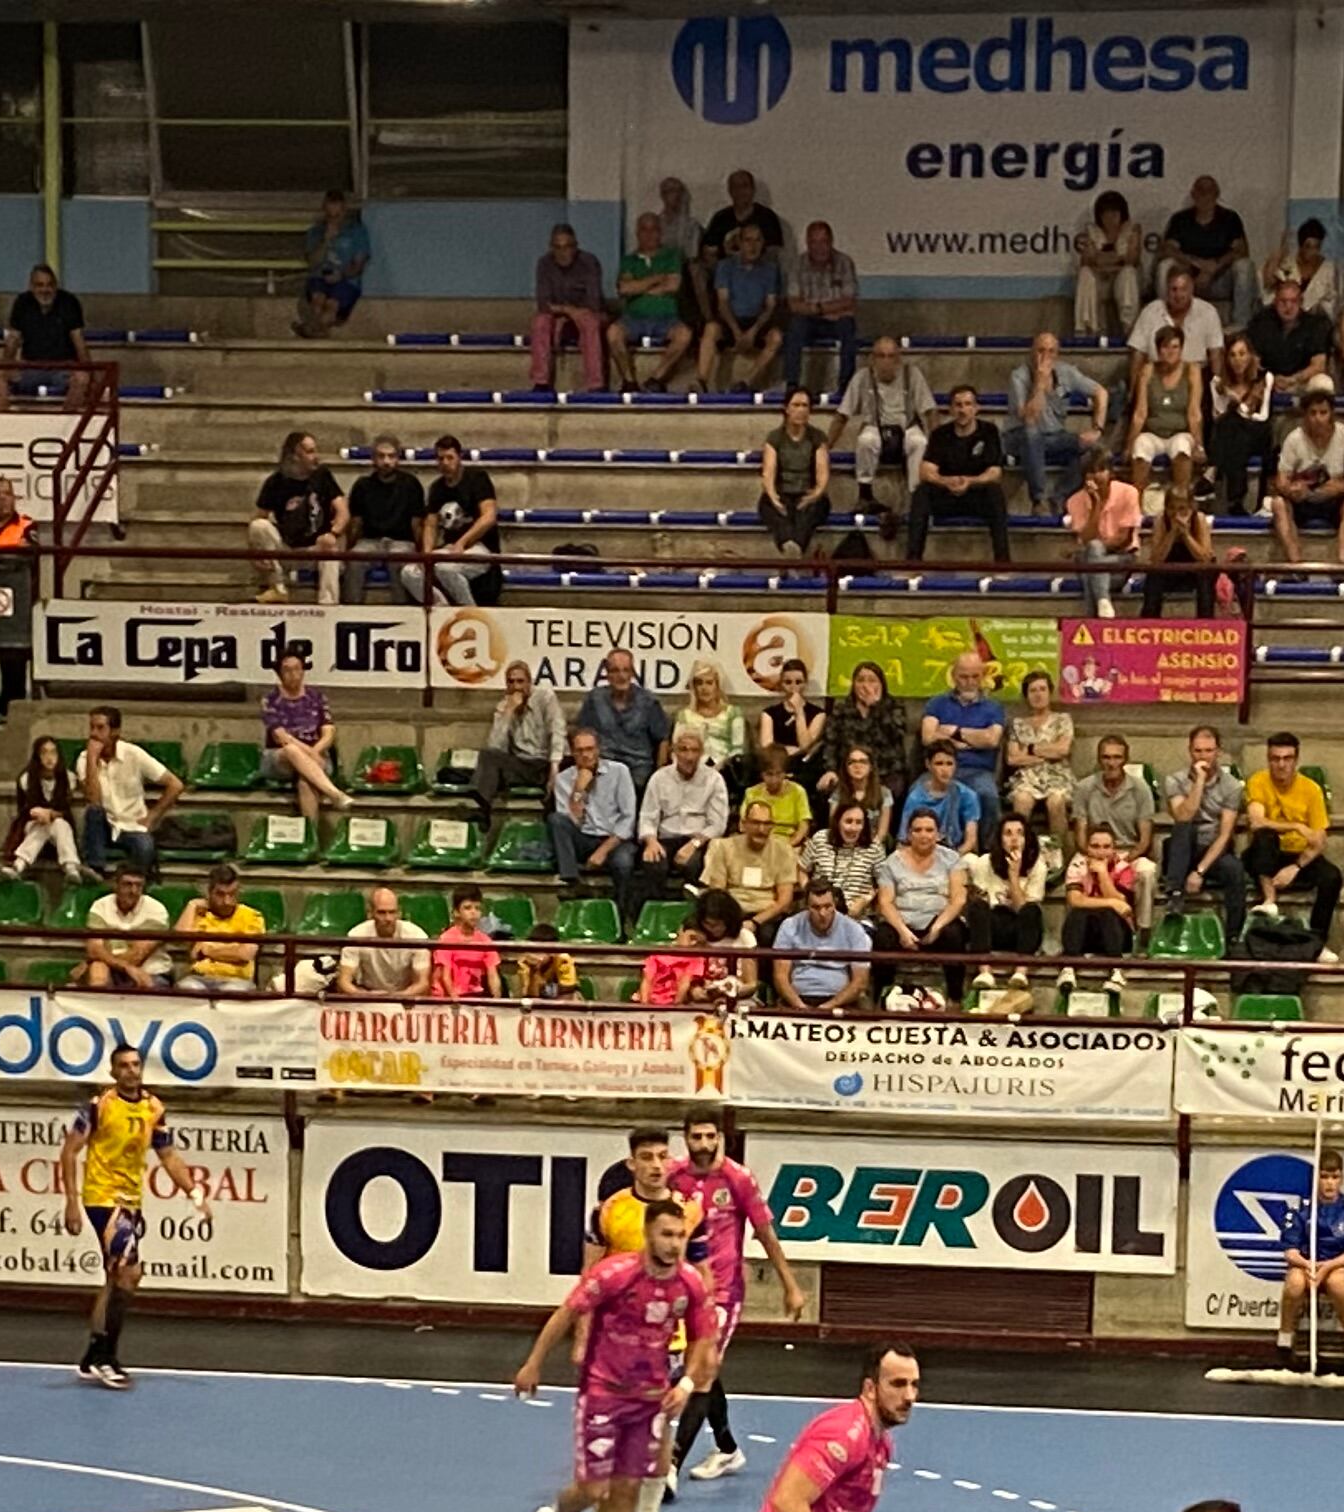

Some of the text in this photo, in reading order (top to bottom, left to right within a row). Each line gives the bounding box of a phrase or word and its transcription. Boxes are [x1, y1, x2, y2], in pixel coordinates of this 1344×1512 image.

[828, 17, 1248, 93] medhesa
[905, 128, 1164, 191] energía
[139, 604, 326, 618] Hostal Restaurante
[526, 614, 718, 652] TELEVISIÓN
[1101, 627, 1240, 647] ELECTRICIDAD
[125, 619, 239, 681] Cepa
[330, 621, 421, 672] Oro
[1157, 652, 1238, 670] ASENSIO
[534, 656, 684, 690] ARAND
[319, 1008, 674, 1052] CHARCUTERÍA CARNICERÍA
[866, 1024, 968, 1048] CUESTA
[978, 1028, 998, 1048] &
[1007, 1030, 1167, 1052] ASOCIADOS
[825, 1051, 1065, 1069] DESPACHO de ABOGADOS
[873, 1072, 1056, 1097] HISPAJURIS
[169, 1124, 269, 1154] ISTERÍA
[20, 1156, 268, 1204] COBAL
[159, 1215, 214, 1243] 060
[1227, 1293, 1280, 1318] Puerta
